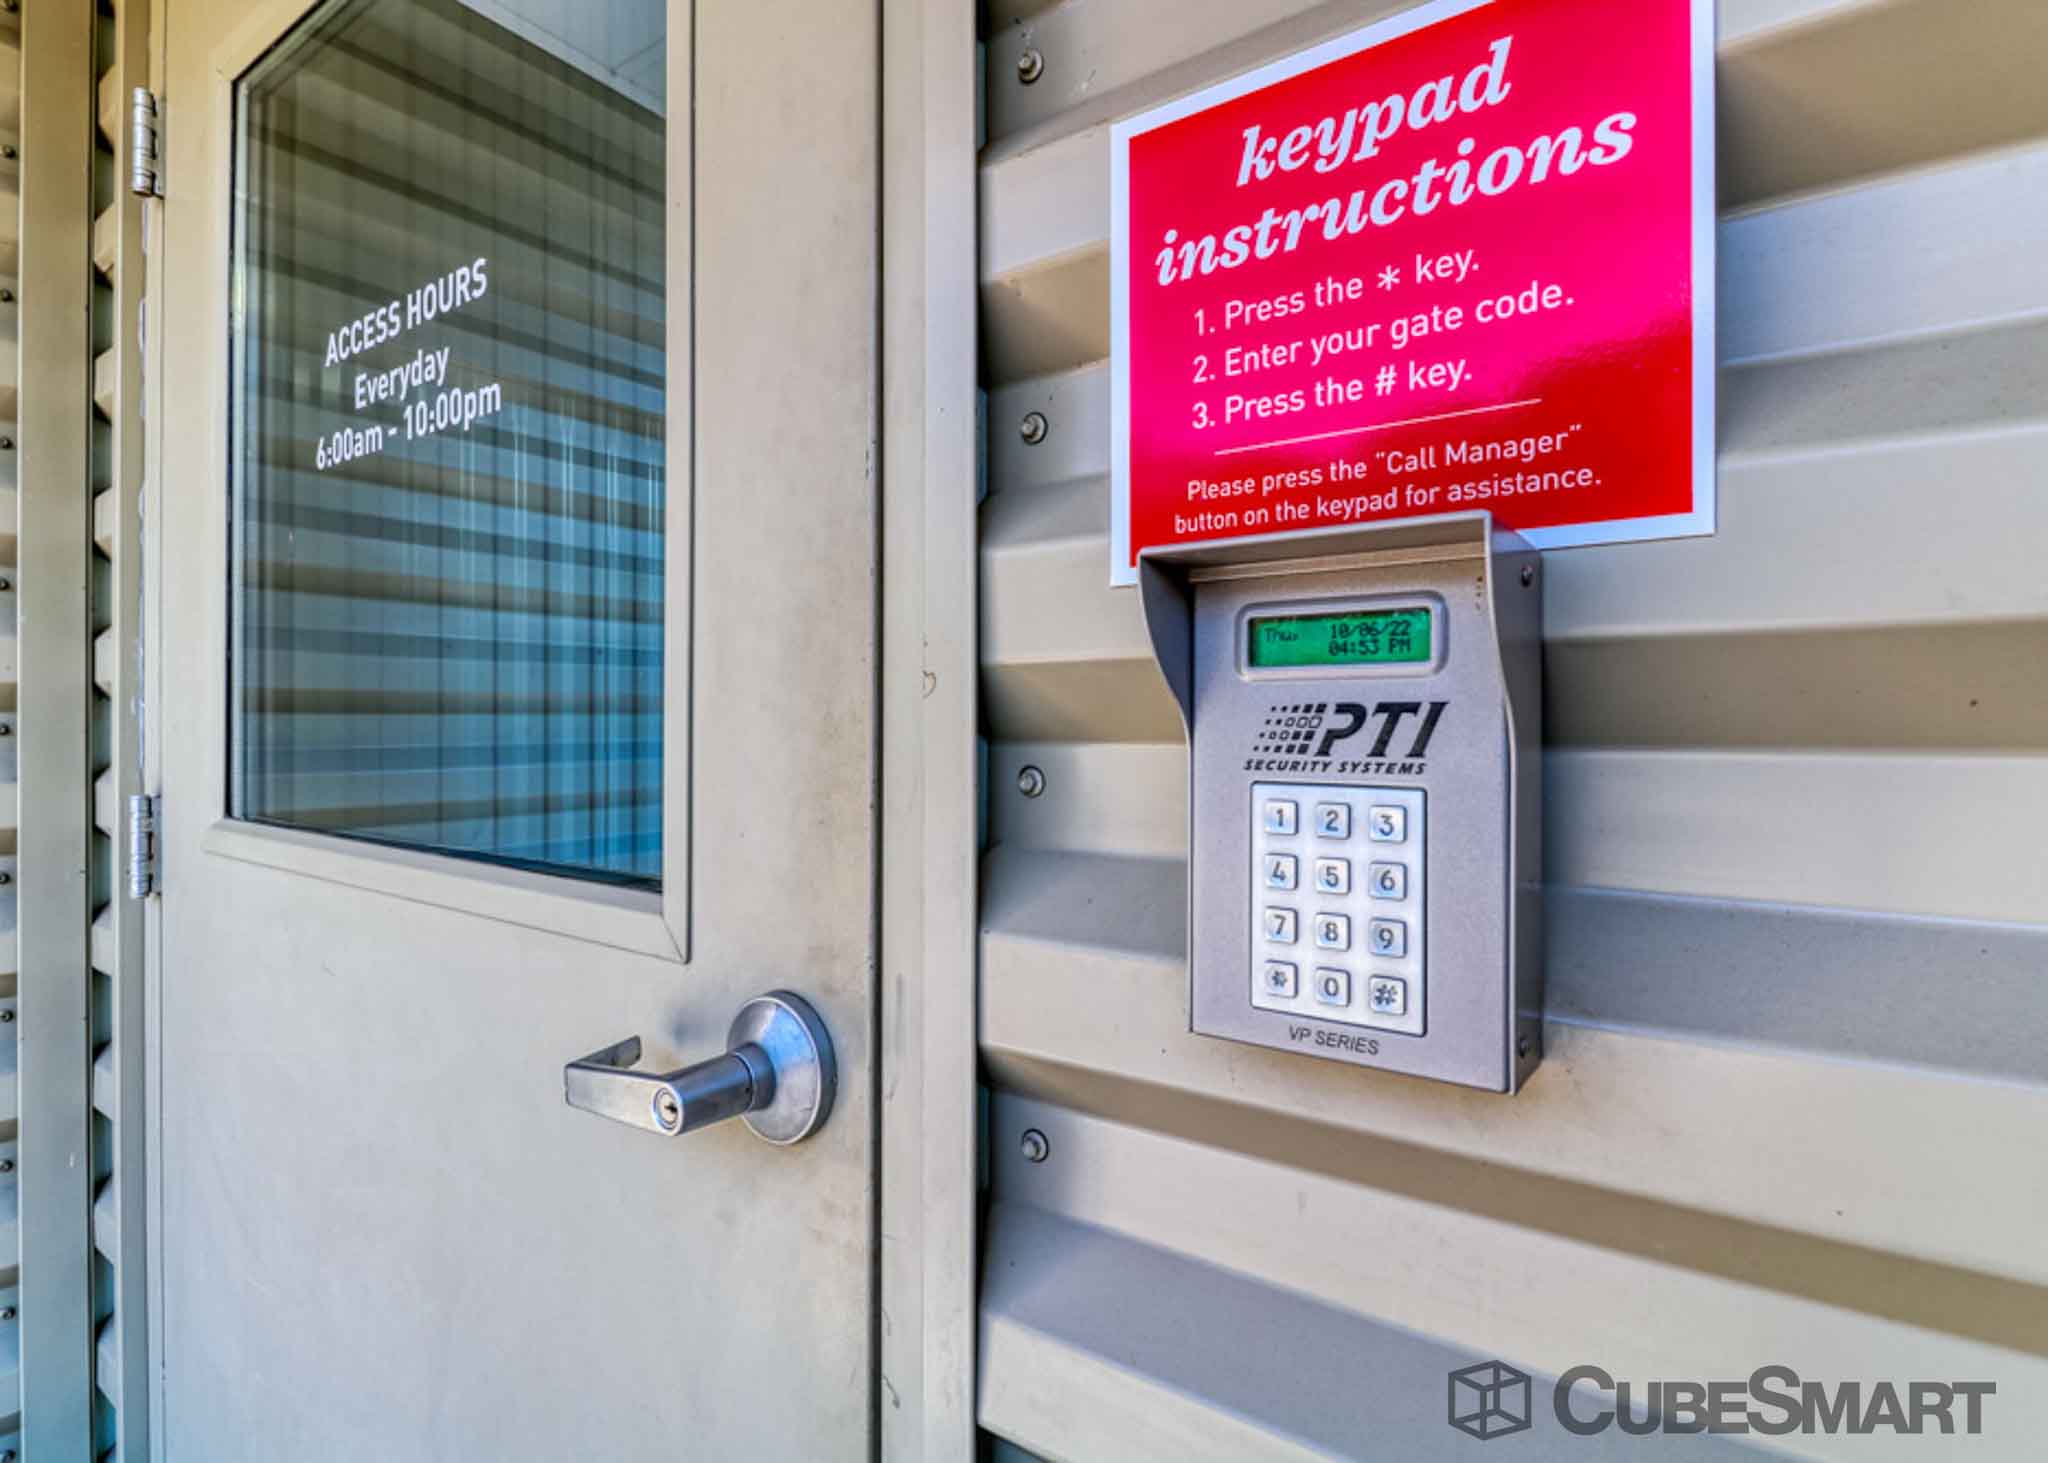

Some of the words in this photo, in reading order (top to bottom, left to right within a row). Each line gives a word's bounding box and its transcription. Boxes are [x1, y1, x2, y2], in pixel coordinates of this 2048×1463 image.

[1236, 36, 1514, 187] keypad
[1154, 111, 1637, 287] instructions
[1194, 309, 1215, 336] 1.
[1225, 291, 1305, 330] Press
[1315, 273, 1363, 307] the
[1415, 249, 1480, 284] key.
[325, 301, 400, 367] ACCESS
[407, 257, 488, 329] HOURS
[1193, 355, 1215, 383] 2.
[1225, 340, 1303, 377] Enter
[1310, 324, 1380, 366] your
[1390, 302, 1463, 349] gate
[1475, 280, 1574, 323] code.
[355, 347, 449, 409] Everyday
[1192, 402, 1215, 429] 3.
[1225, 386, 1305, 423] Press
[1315, 373, 1363, 407] the
[1408, 358, 1472, 392] key.
[316, 425, 382, 470] 6:00am
[403, 383, 501, 440] 10:00pm
[1187, 477, 1255, 501] Please
[1262, 467, 1323, 494] press
[1329, 457, 1367, 481] the
[1174, 511, 1238, 534] button
[1244, 507, 1269, 526] on
[1275, 499, 1310, 522] the
[1316, 486, 1398, 518] keypad
[1405, 484, 1437, 506] for
[1447, 466, 1601, 502] assistance.
[1328, 640, 1379, 657] 04:53
[1389, 637, 1411, 653] PM
[1313, 702, 1449, 758] PTI
[1244, 758, 1331, 772] SECURITY
[1337, 760, 1426, 775] SYSTEMS
[1277, 808, 1285, 827] 1
[1326, 810, 1339, 831] 2
[1379, 815, 1394, 836] 3
[1272, 861, 1286, 881] 4
[1325, 866, 1339, 888] 5
[1380, 869, 1396, 891] 6
[1273, 915, 1286, 935] 7
[1325, 922, 1339, 943] 8
[1379, 927, 1395, 949] 9
[1324, 977, 1340, 998] 0
[1289, 1024, 1312, 1042] VP
[1314, 1031, 1380, 1056] SERIES
